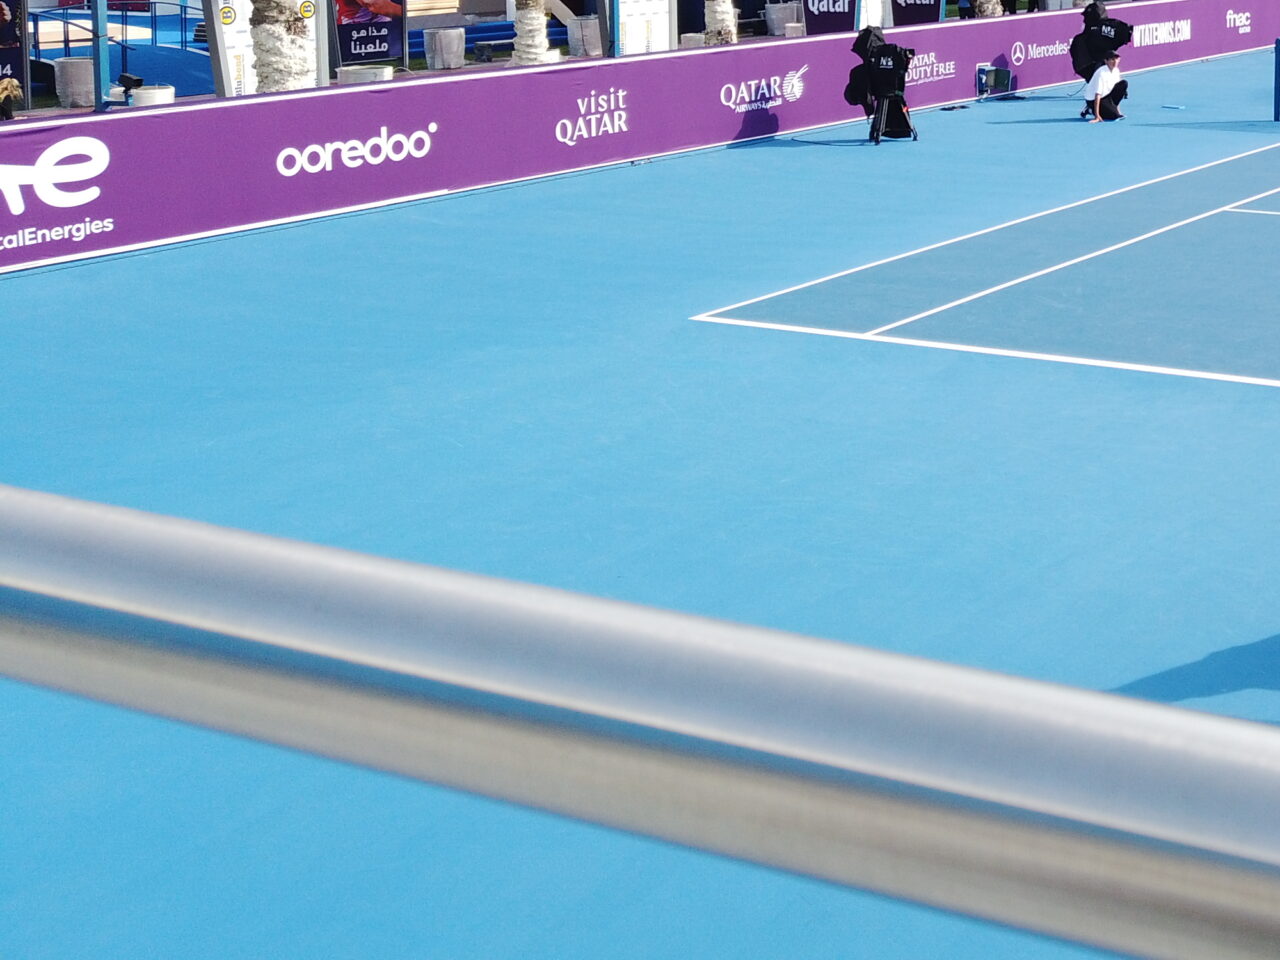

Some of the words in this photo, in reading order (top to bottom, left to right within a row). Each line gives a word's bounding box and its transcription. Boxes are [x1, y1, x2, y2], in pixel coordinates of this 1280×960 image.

[1225, 9, 1251, 29] fnac
[351, 29, 367, 40] هو
[368, 26, 388, 36] هذا
[1133, 19, 1191, 48] WTATENNIS.COM
[351, 39, 389, 56] ملعبنا
[1028, 38, 1073, 59] Mercedes-
[905, 66, 932, 82] DUTY
[933, 61, 956, 77] FREE
[577, 87, 628, 115] visit
[720, 76, 782, 110] QATAR
[735, 100, 761, 113] AIRWAYS
[555, 110, 628, 146] QATAR
[276, 125, 434, 177] ooredoo
[0, 217, 114, 250] alEnergies
